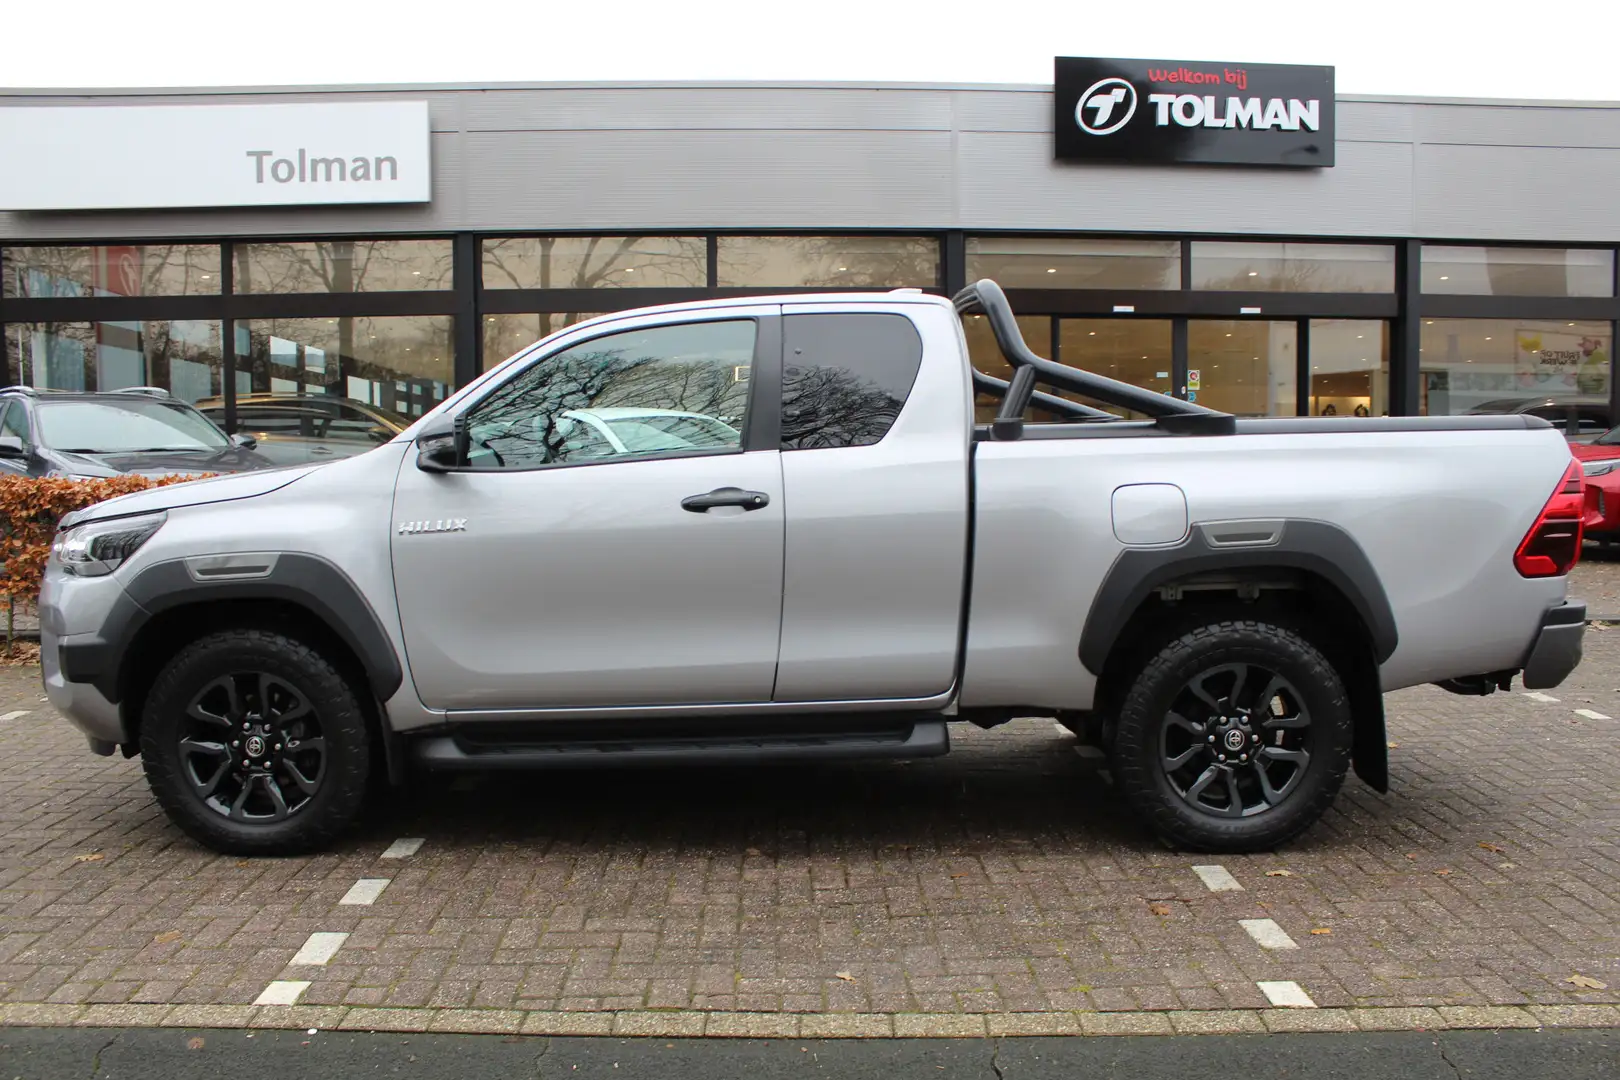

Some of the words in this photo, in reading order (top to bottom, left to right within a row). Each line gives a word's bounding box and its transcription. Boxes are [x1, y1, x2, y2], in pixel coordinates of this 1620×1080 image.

[1147, 67, 1220, 85] Welkom
[1223, 67, 1248, 90] bij
[1149, 93, 1320, 132] TOLMAN
[246, 148, 398, 184] Tolman
[398, 518, 468, 535] HILUX
